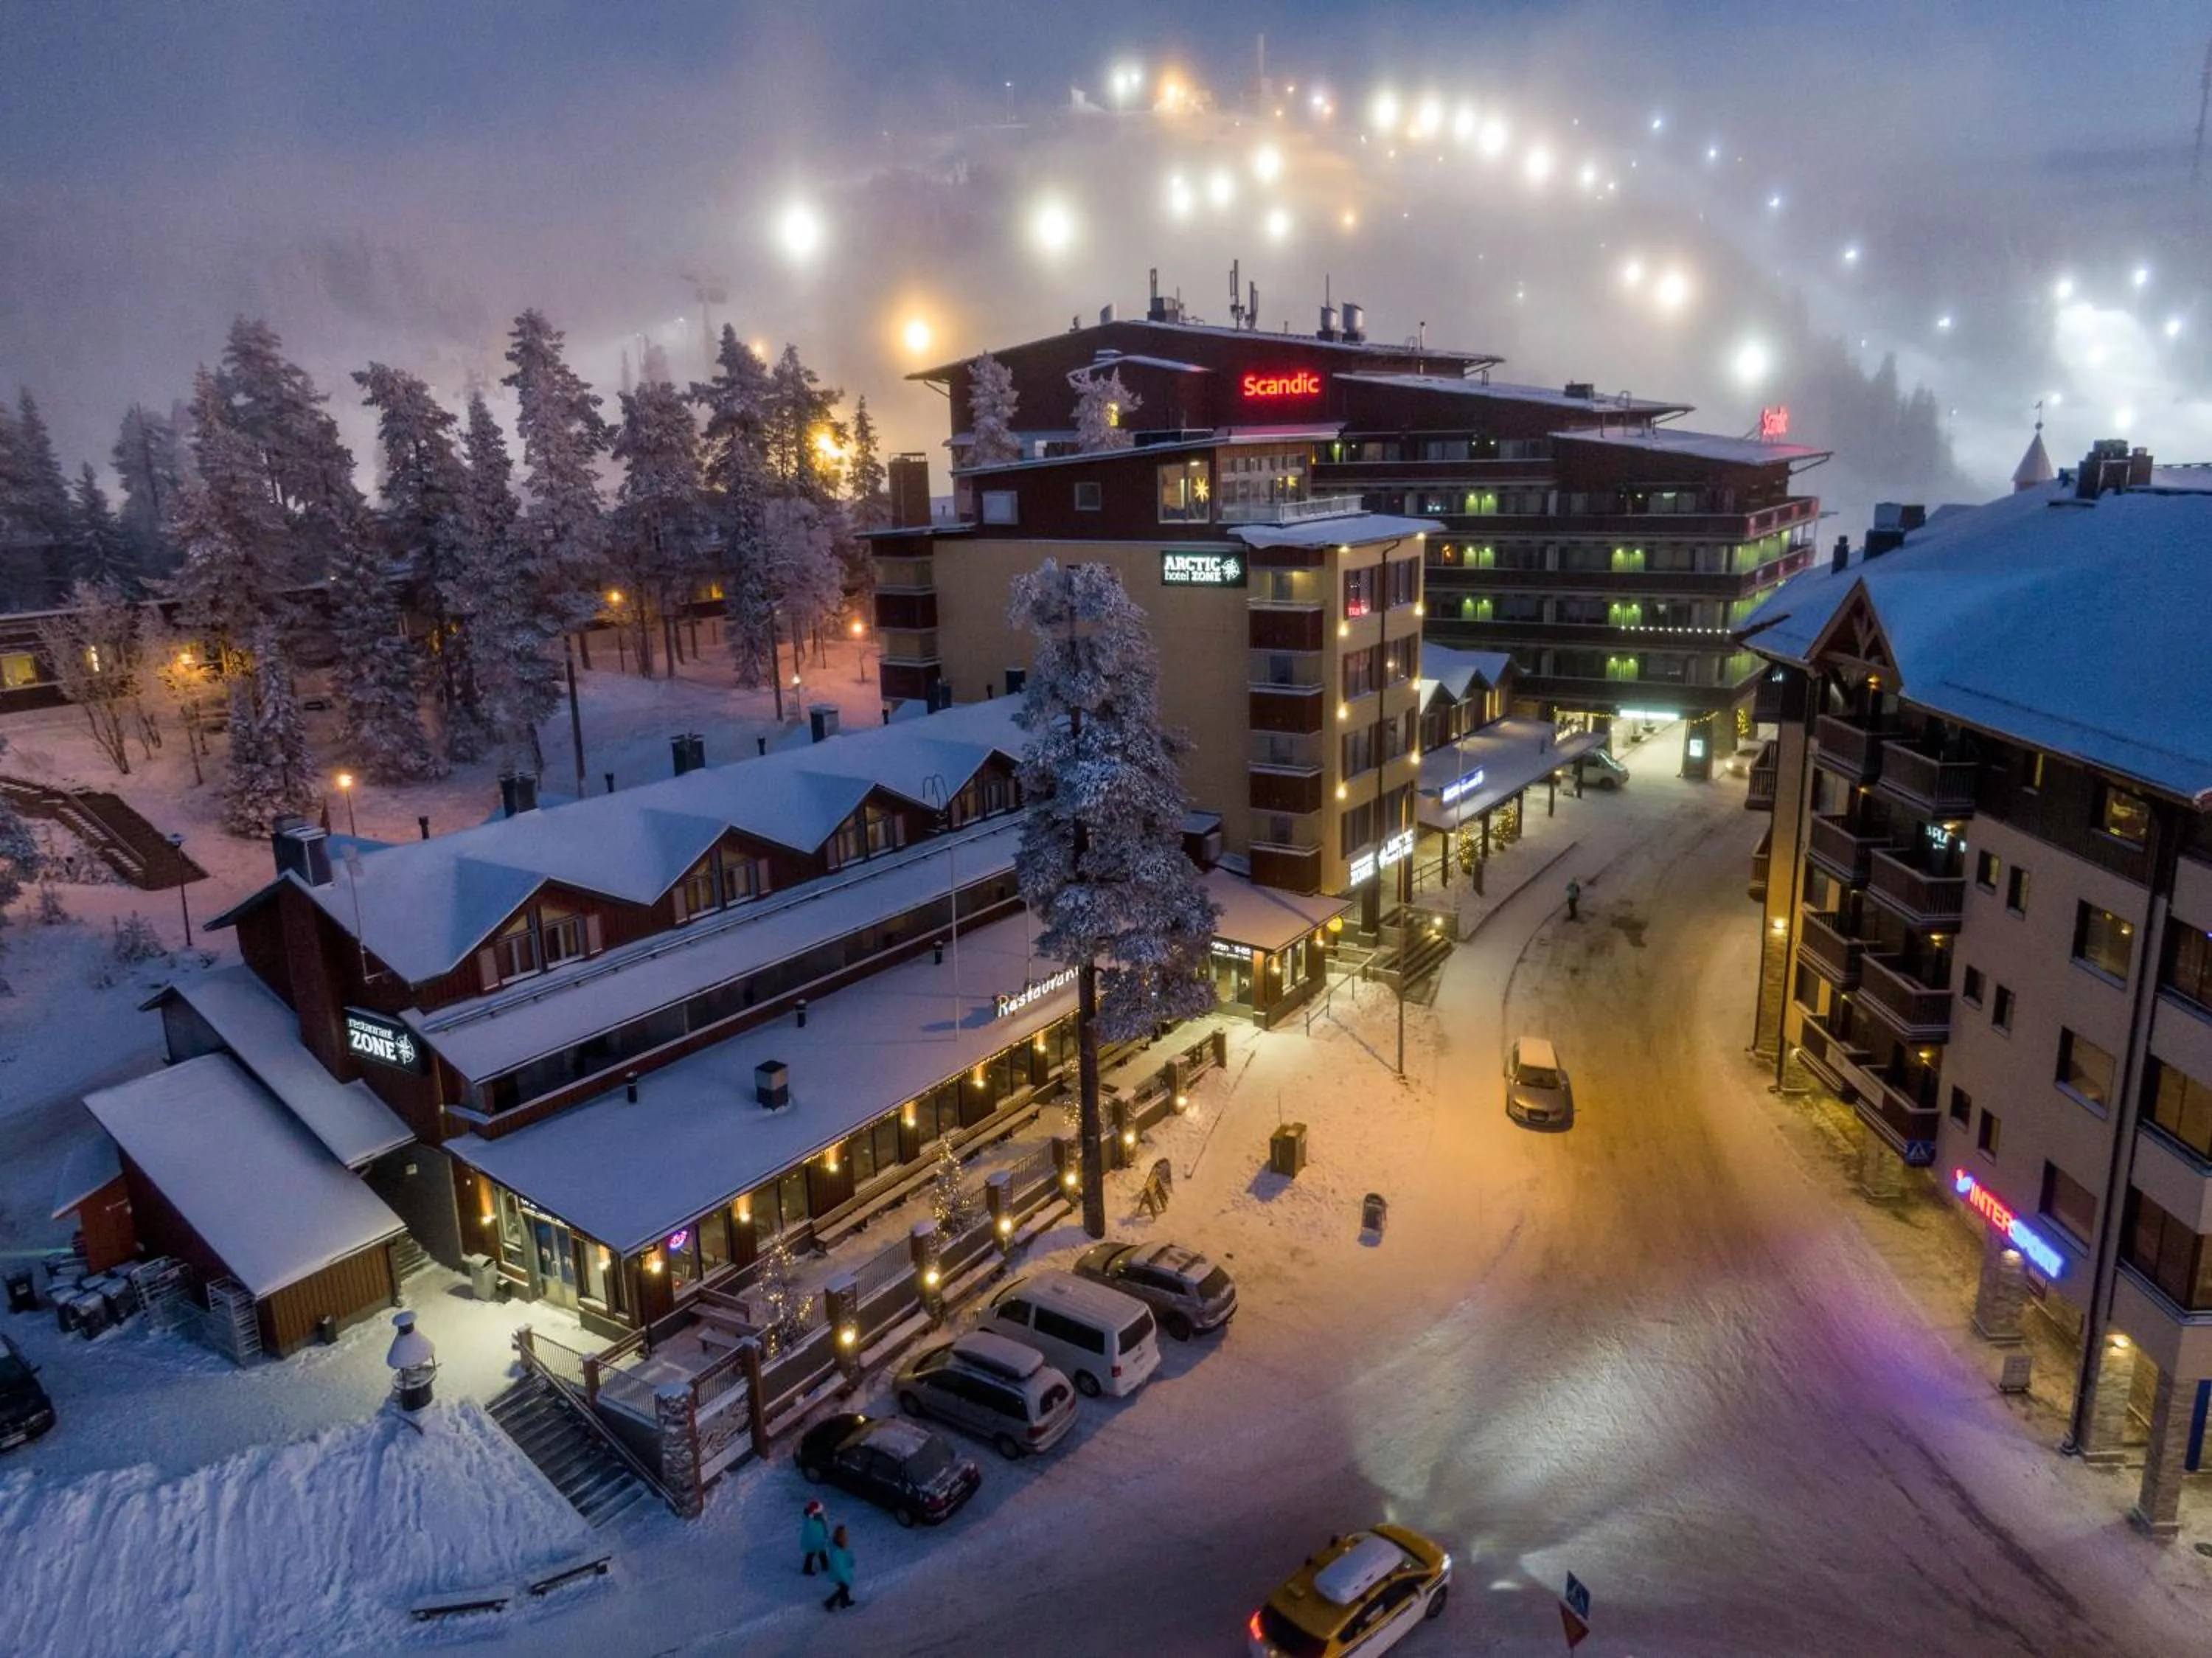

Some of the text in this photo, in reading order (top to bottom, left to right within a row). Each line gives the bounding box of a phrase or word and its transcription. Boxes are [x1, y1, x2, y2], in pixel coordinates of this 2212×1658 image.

[1244, 372, 1320, 396] Scandic
[1164, 555, 1221, 571] ARCTIC
[1164, 569, 1222, 582] hotel ZONE
[349, 1029, 397, 1061] ZONE
